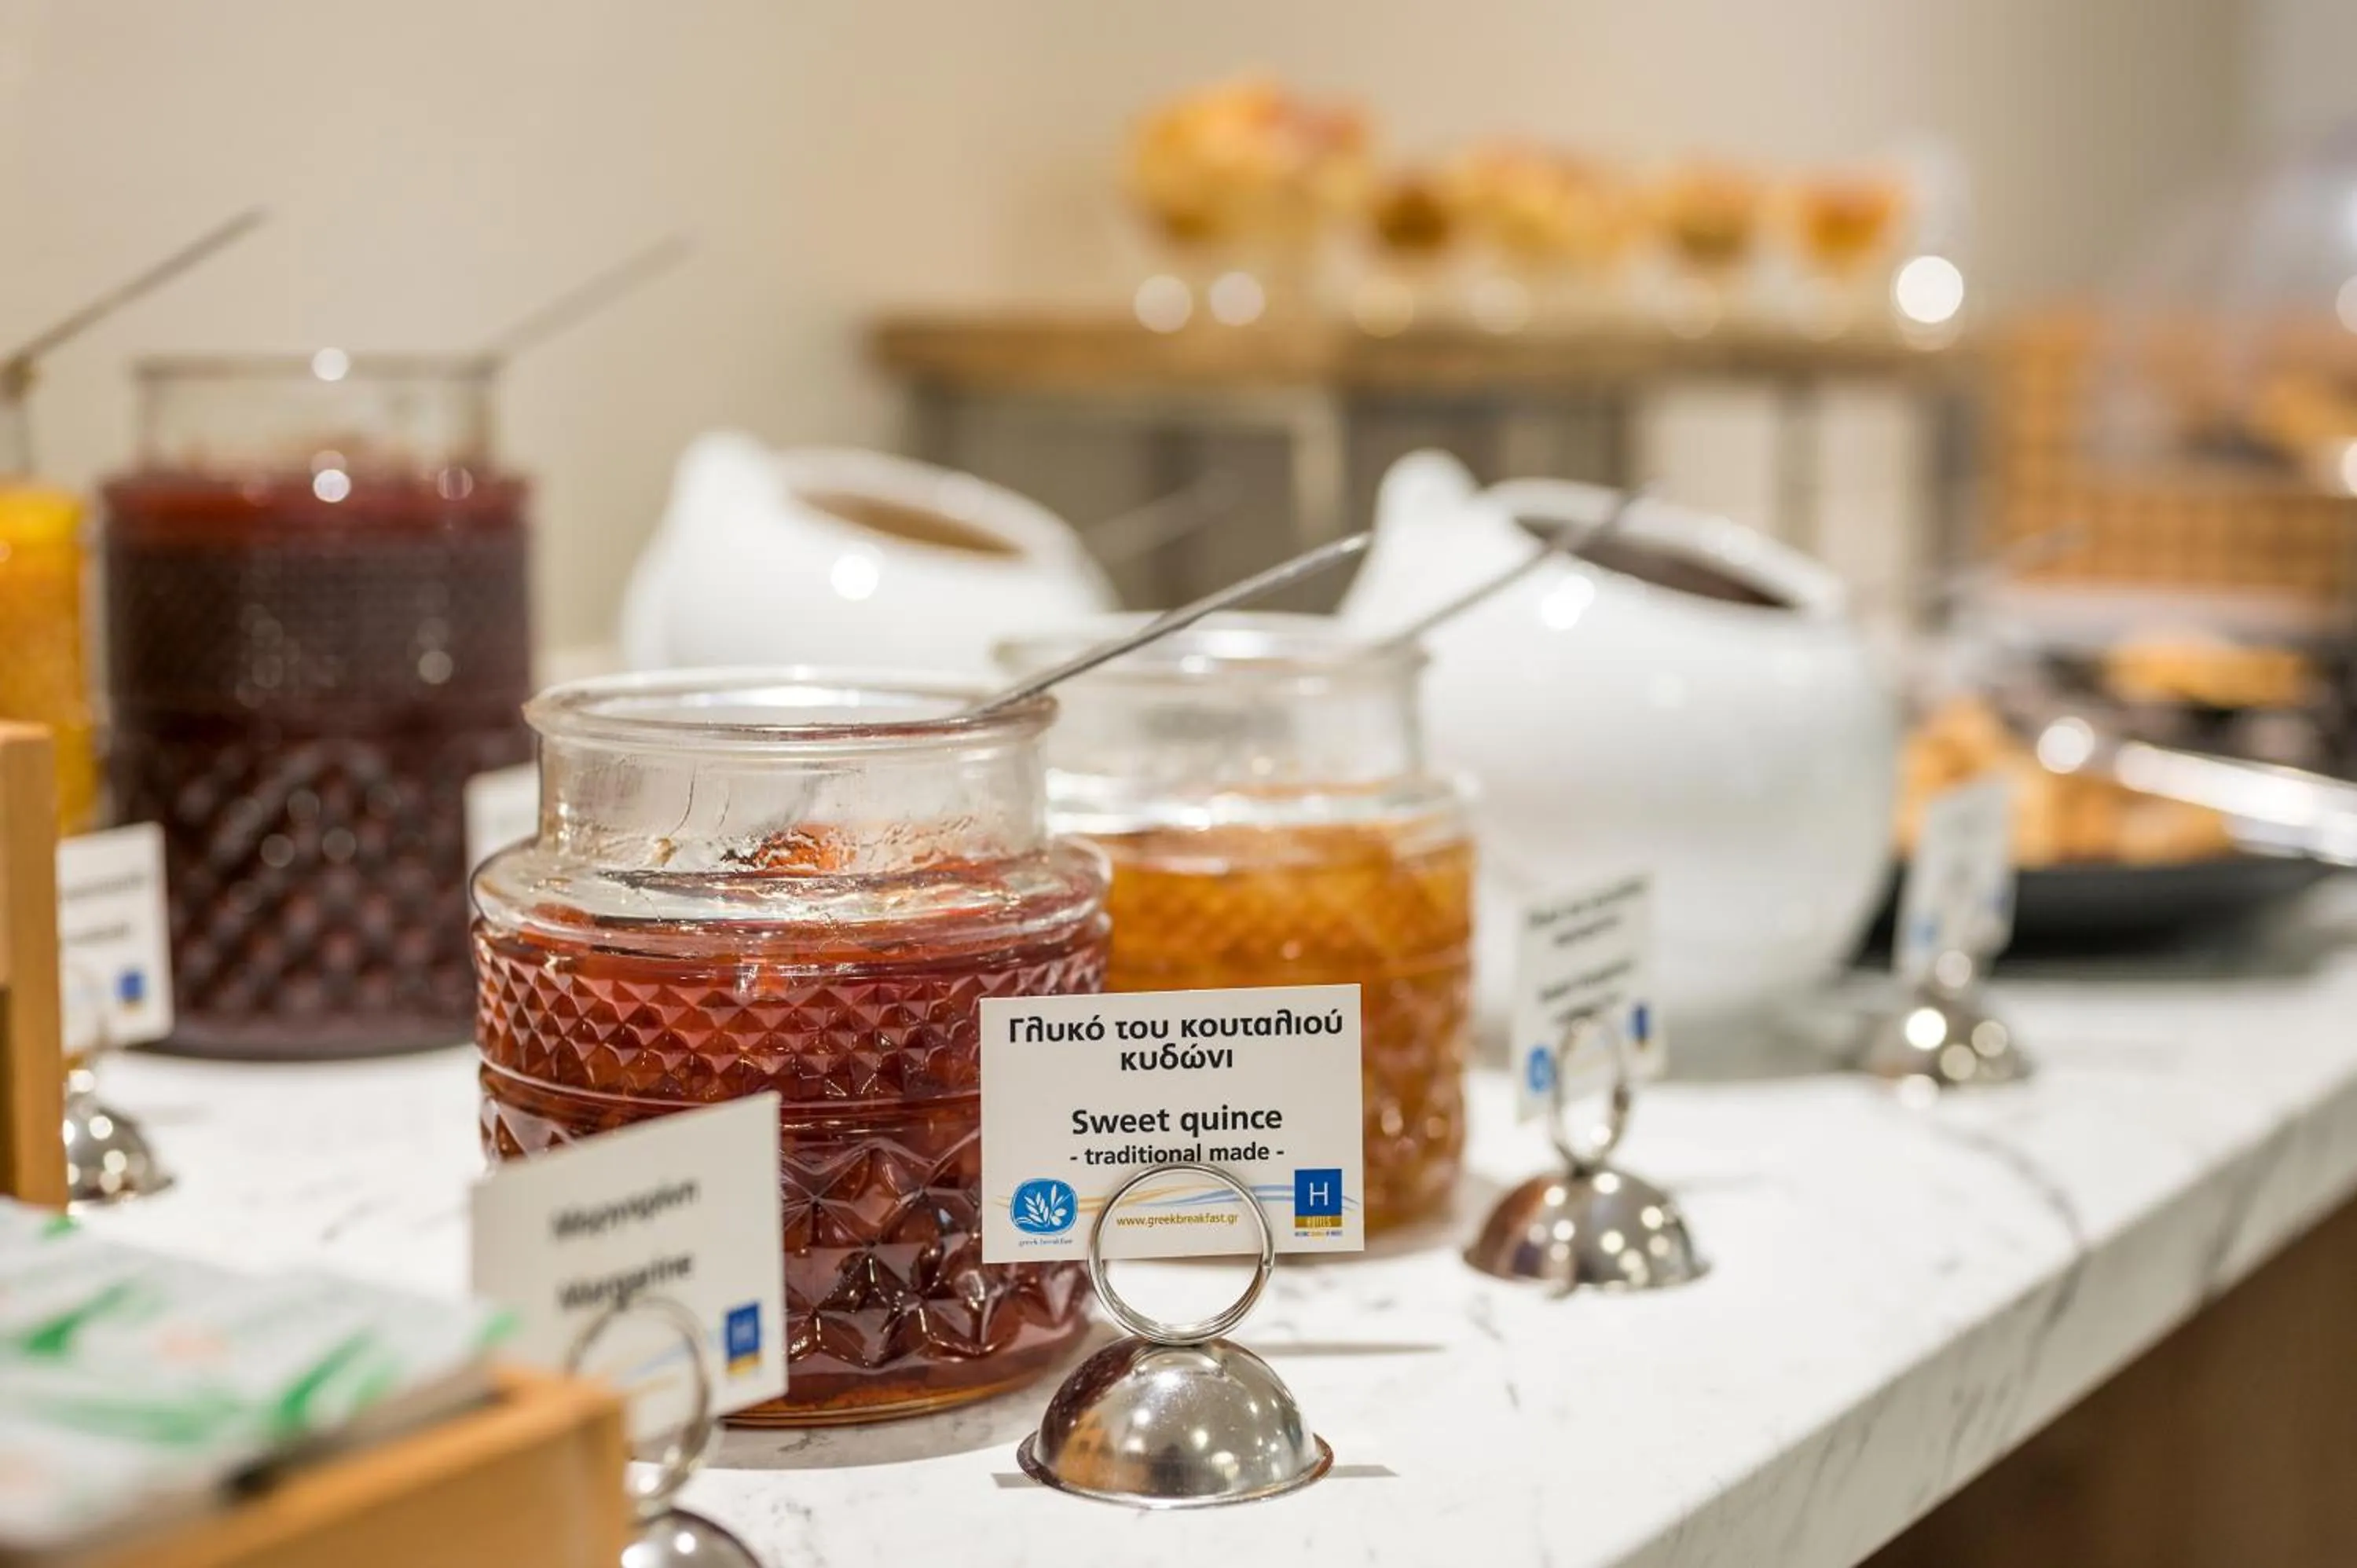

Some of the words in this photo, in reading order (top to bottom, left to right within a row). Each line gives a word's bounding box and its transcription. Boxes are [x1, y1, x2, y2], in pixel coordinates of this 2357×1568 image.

[1009, 1015, 1106, 1043] Γλυκό
[1115, 1019, 1169, 1040] του
[1181, 1009, 1343, 1038] κουταλιού
[1120, 1043, 1233, 1072] κυδώνι
[1072, 1108, 1171, 1134] Sweet
[1180, 1105, 1283, 1138] quince
[1083, 1144, 1202, 1165] traditional
[1208, 1141, 1270, 1162] made
[1309, 1181, 1329, 1207] H
[1116, 1212, 1238, 1228] www.greekbreakfast.gr
